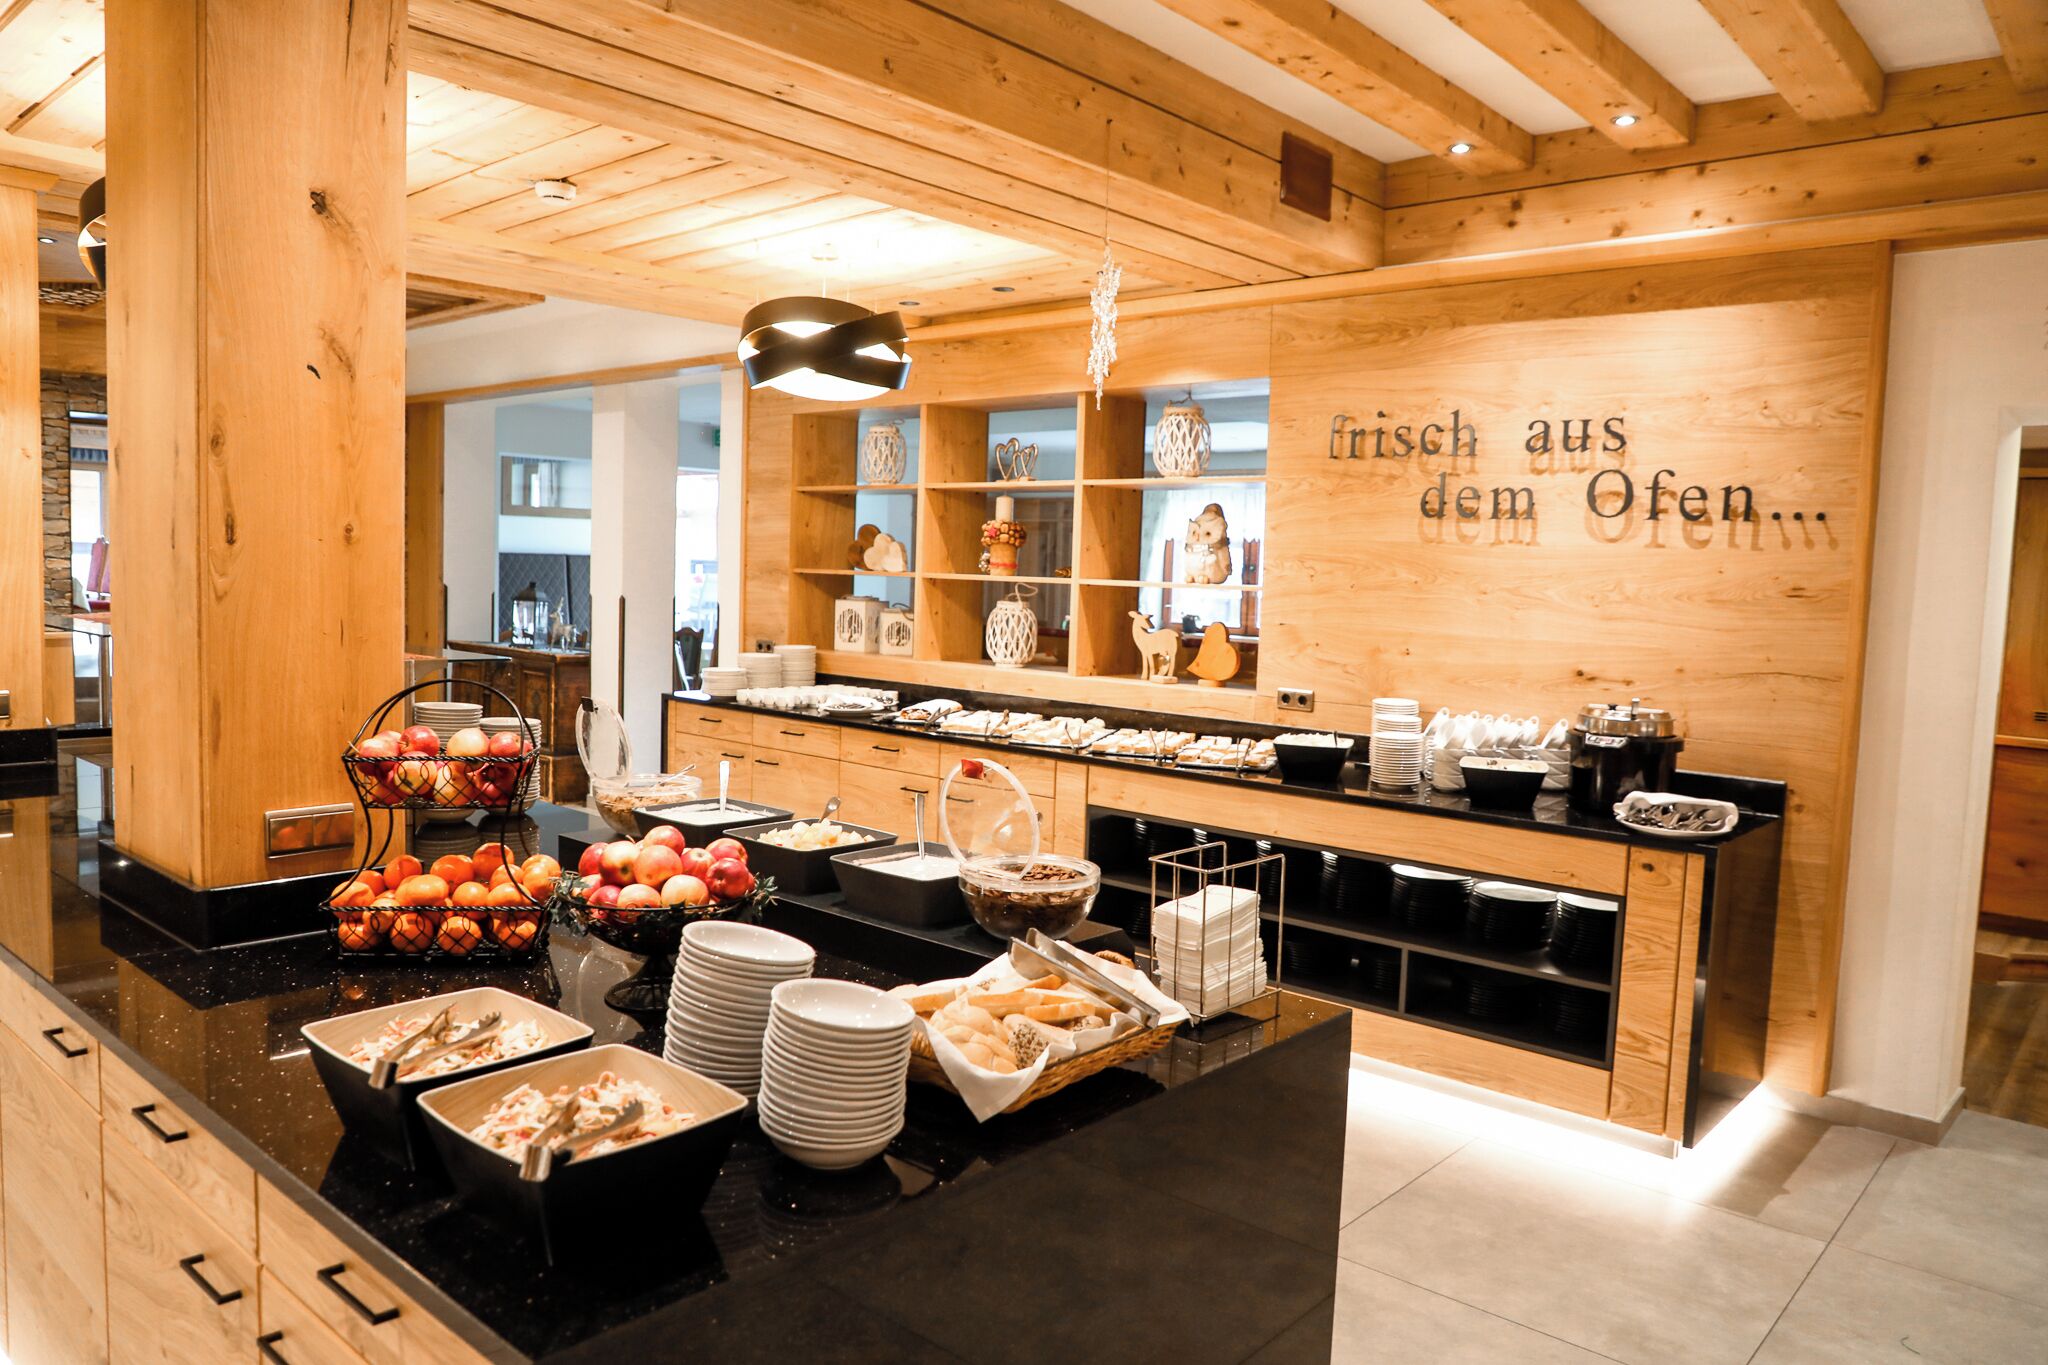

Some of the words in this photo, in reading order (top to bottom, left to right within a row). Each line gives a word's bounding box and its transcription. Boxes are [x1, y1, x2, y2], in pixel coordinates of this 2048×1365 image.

[1329, 410, 1477, 459] frisch
[1525, 416, 1627, 453] aus
[1420, 472, 1535, 520] dem
[1586, 468, 1827, 522] Ofen...
